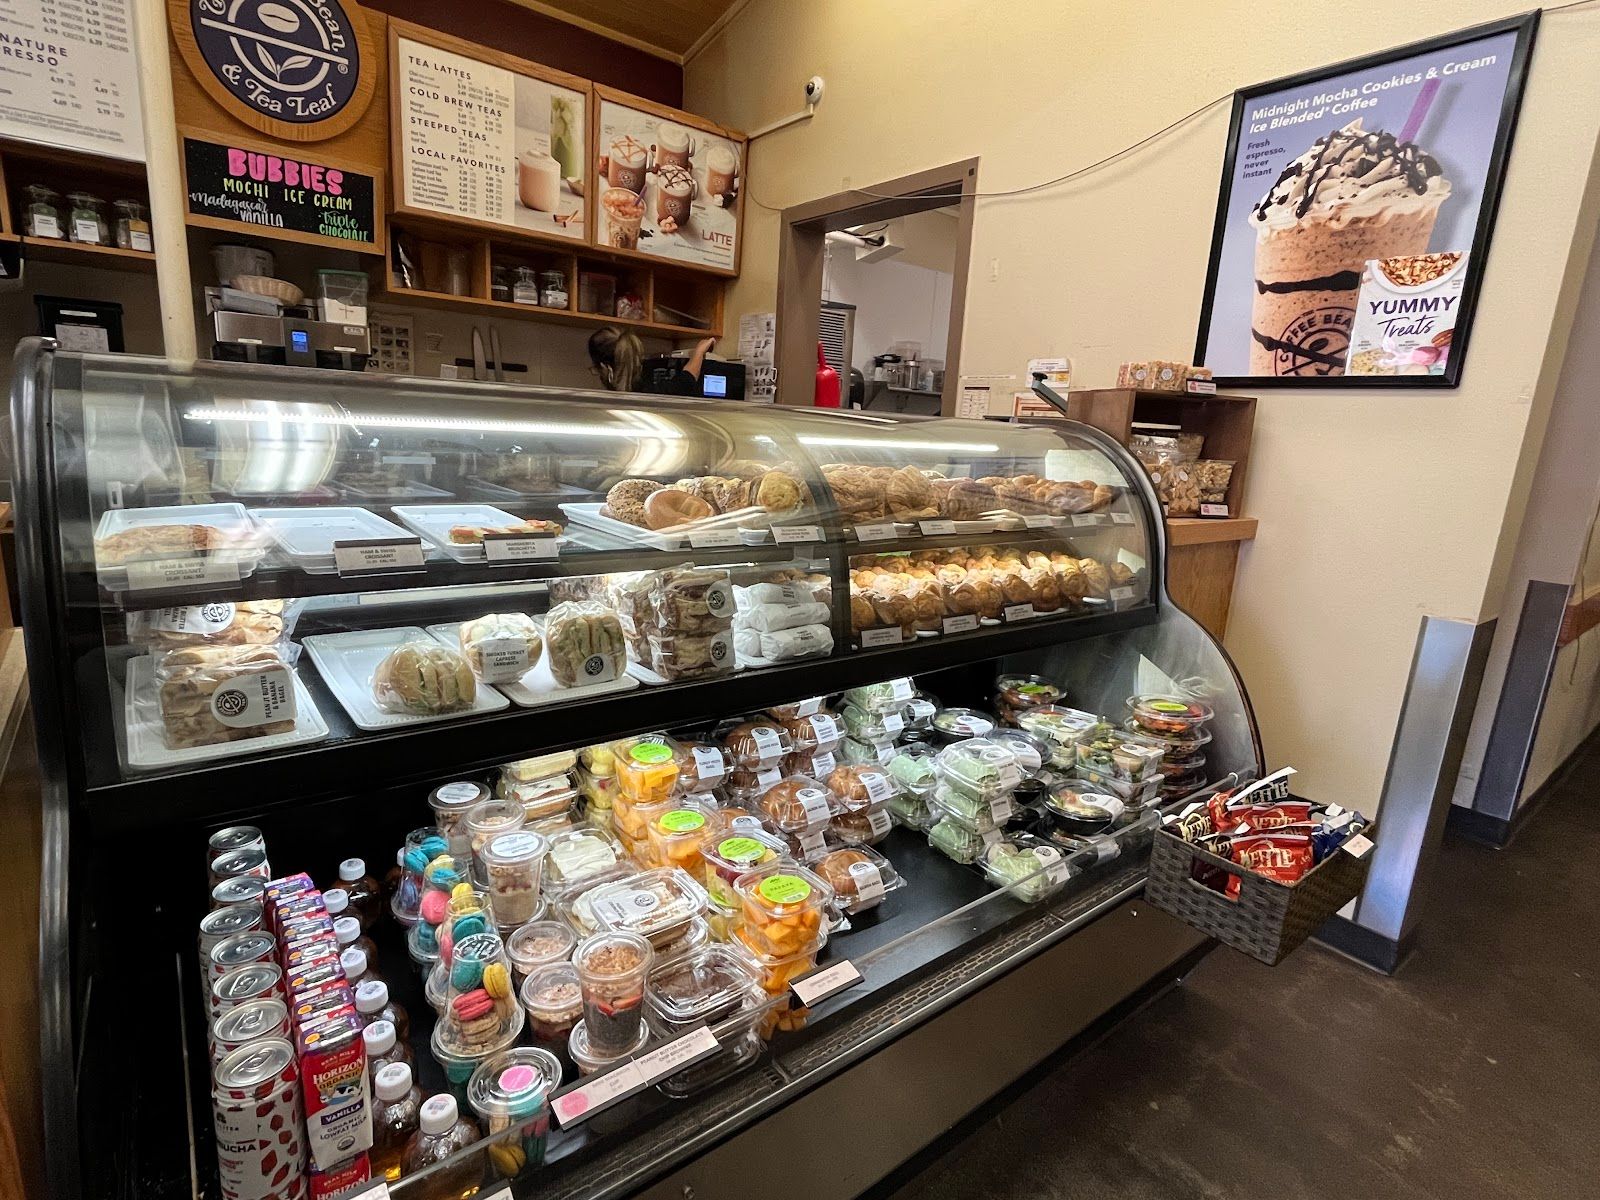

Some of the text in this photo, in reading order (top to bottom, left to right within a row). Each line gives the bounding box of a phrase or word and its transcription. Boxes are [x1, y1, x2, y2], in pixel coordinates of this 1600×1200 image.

[408, 55, 471, 80] TEA LATTES
[222, 63, 337, 116] & Tea Leaf
[1251, 55, 1496, 121] Midnight Mocha Cookies & Cream
[409, 86, 502, 117] COLD BREW TEAS
[1249, 122, 1268, 134] Ice
[1332, 96, 1377, 115] Coffee
[410, 116, 457, 134] STEEPED
[462, 129, 487, 141] TEAS
[1245, 147, 1286, 160] espresso,
[1247, 139, 1270, 150] Fresh
[411, 145, 446, 160] LOCAL
[450, 154, 505, 174] FAVORITES
[1244, 160, 1269, 169] never
[227, 148, 343, 196] BUBBIES
[1242, 168, 1272, 179] instant
[223, 178, 352, 211] MOCHI ICE CREAM
[702, 229, 732, 246] LATTE
[1369, 296, 1458, 315] YUMMY
[1377, 314, 1439, 338] Treats
[1279, 314, 1352, 363] CFFEE BEA
[313, 1056, 363, 1085] HORIZON
[319, 1068, 362, 1090] ORGANIC
[325, 1104, 361, 1122] VANILLA
[327, 1115, 362, 1133] ORGANIC
[320, 1116, 367, 1140] LOWFAT MILK
